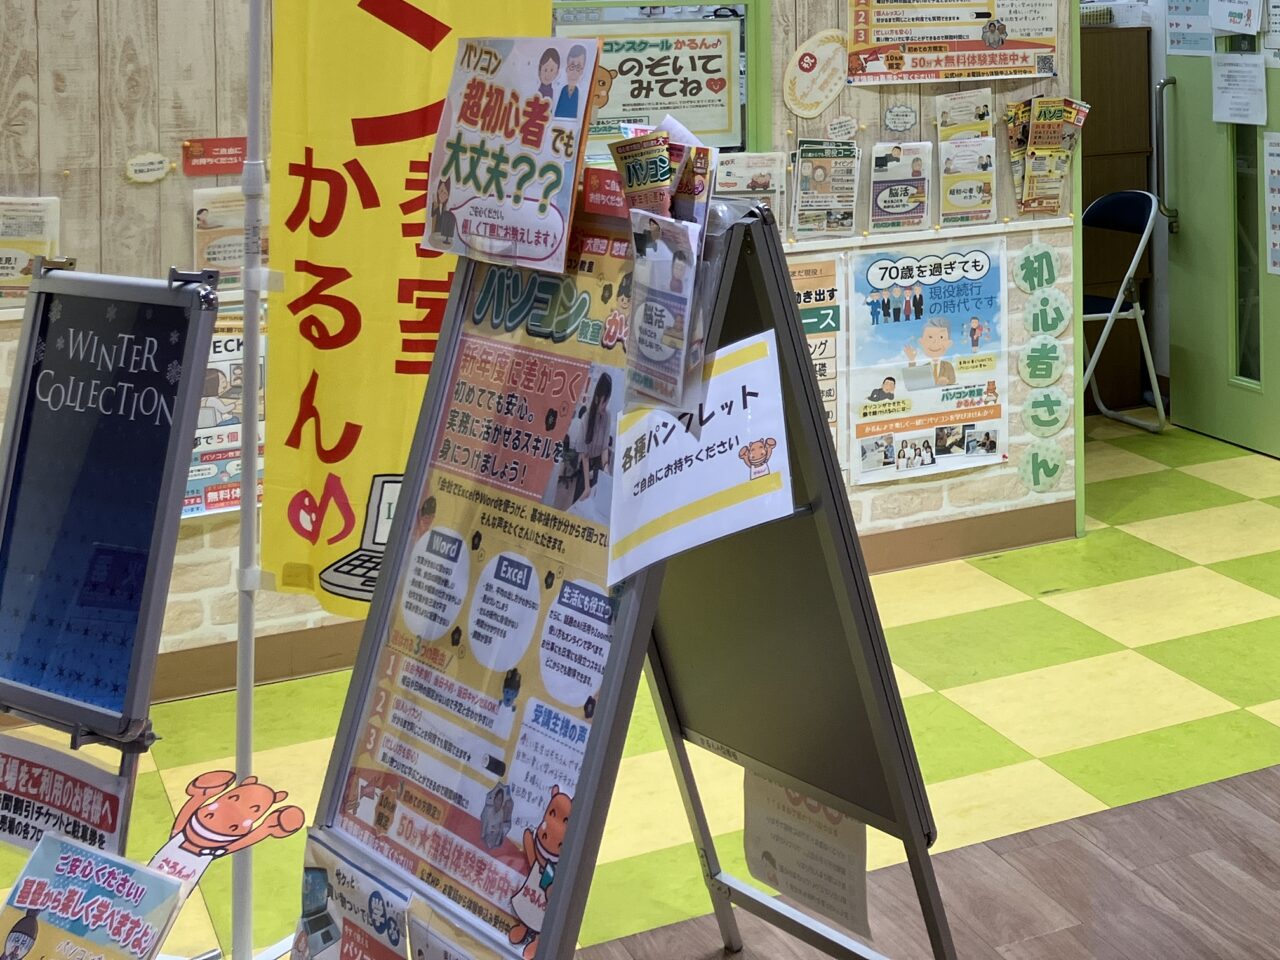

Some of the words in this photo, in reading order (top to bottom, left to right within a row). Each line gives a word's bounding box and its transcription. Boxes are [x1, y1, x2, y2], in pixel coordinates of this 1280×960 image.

[460, 42, 502, 76] パソコン
[673, 39, 713, 50] かるん
[618, 53, 723, 77] のぞいて
[630, 77, 702, 99] みてね
[457, 78, 551, 150] 超初心者
[551, 126, 574, 159] でも
[878, 257, 985, 282] 70歳を過ぎても
[284, 146, 381, 465] かるん
[928, 282, 983, 300] 現役続行
[928, 294, 996, 315] の時代です
[68, 327, 159, 375] WINTER
[1020, 250, 1065, 487] 初心者さん
[35, 369, 178, 427] COLLECTION
[621, 384, 760, 476] 各種パンフレット
[632, 436, 741, 497] ご自由にお持ちください
[431, 532, 459, 558] Word
[499, 560, 528, 584] Excel
[0, 793, 106, 850] 間割引チケットと駐車券を
